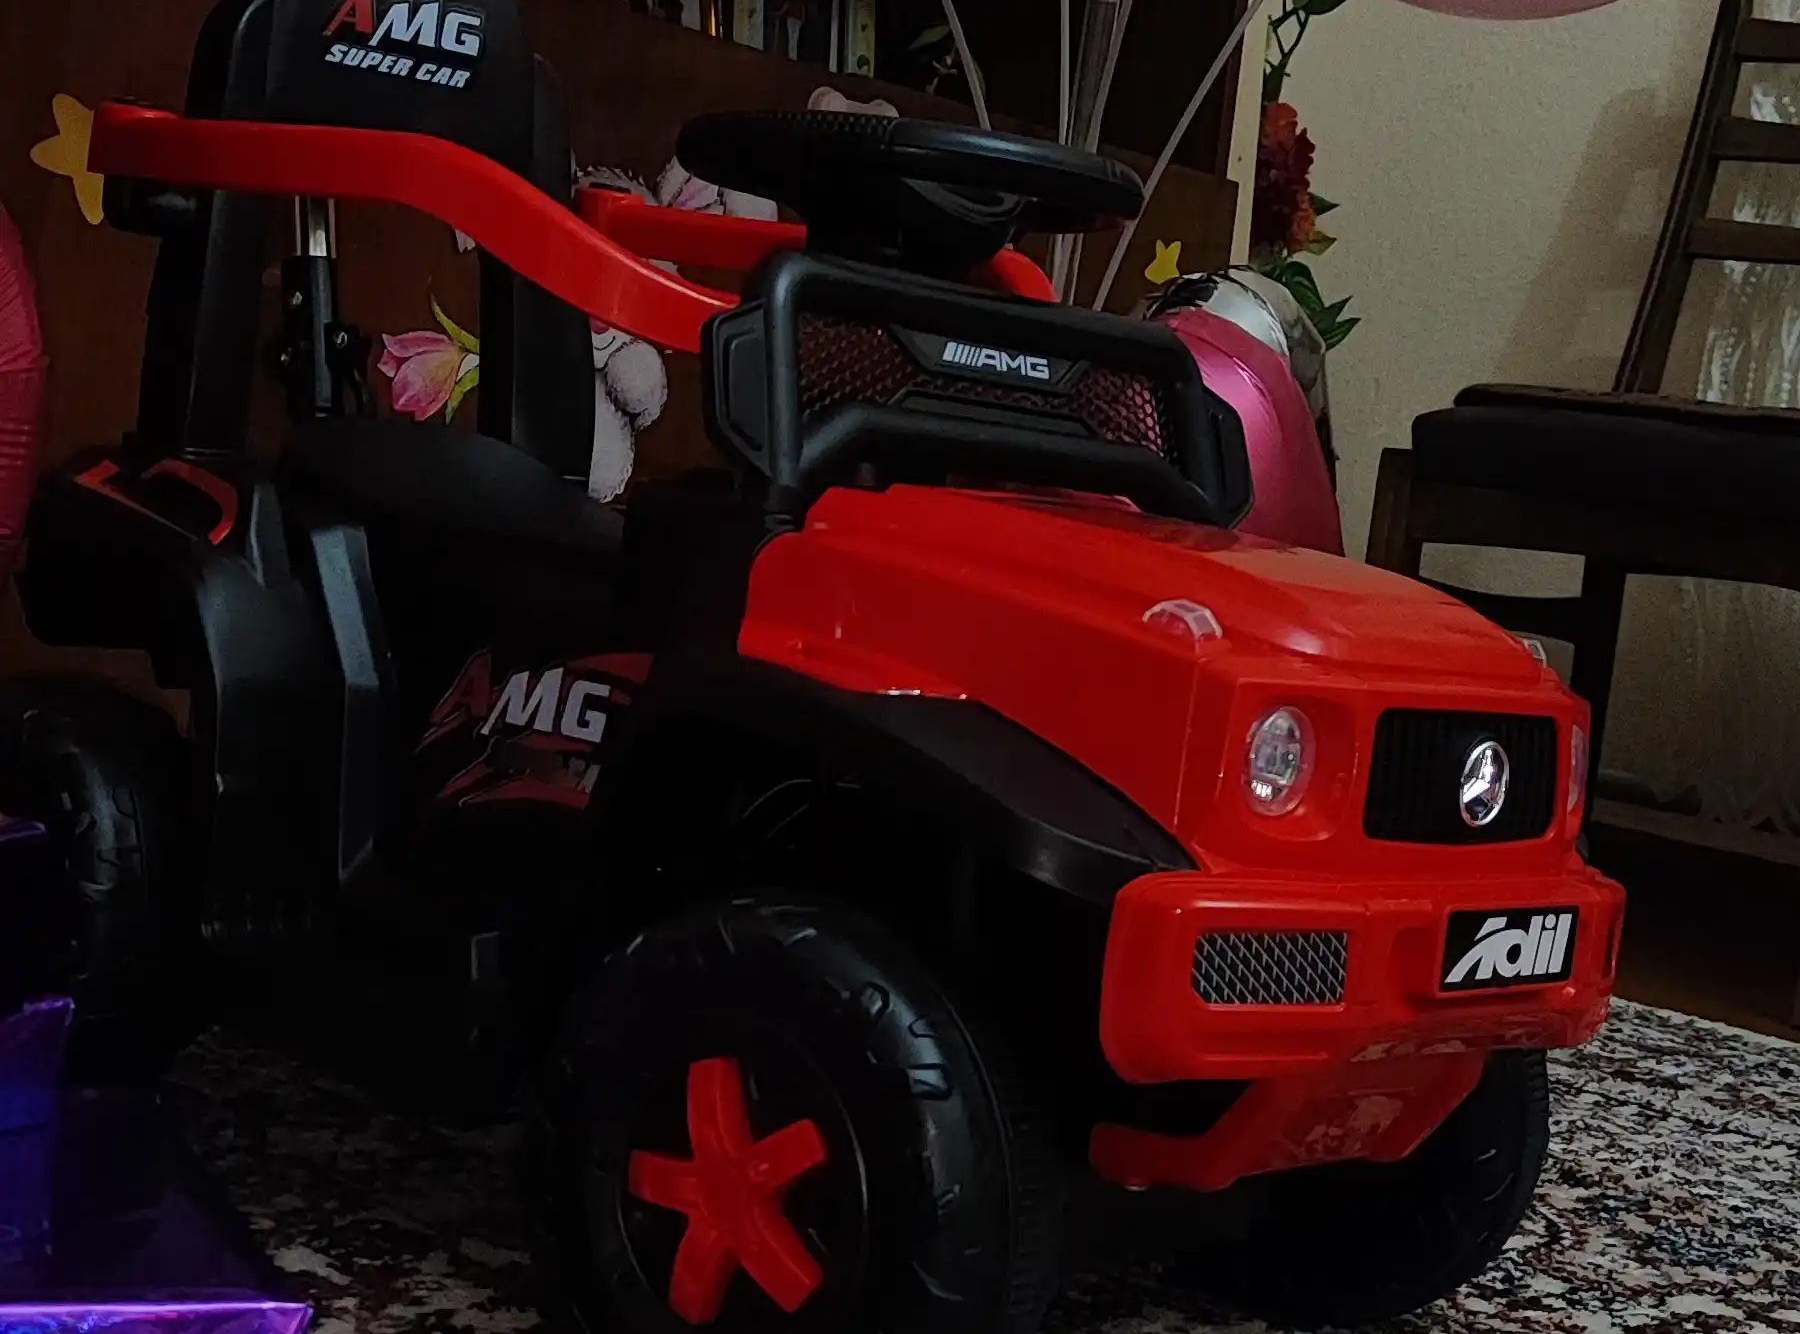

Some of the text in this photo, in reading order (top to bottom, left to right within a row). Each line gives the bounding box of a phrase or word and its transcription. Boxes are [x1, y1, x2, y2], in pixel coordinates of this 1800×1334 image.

[324, 43, 472, 89] SUPER CAR
[978, 346, 1050, 380] AMG
[413, 647, 613, 756] AMG
[1444, 913, 1573, 984] Adil
